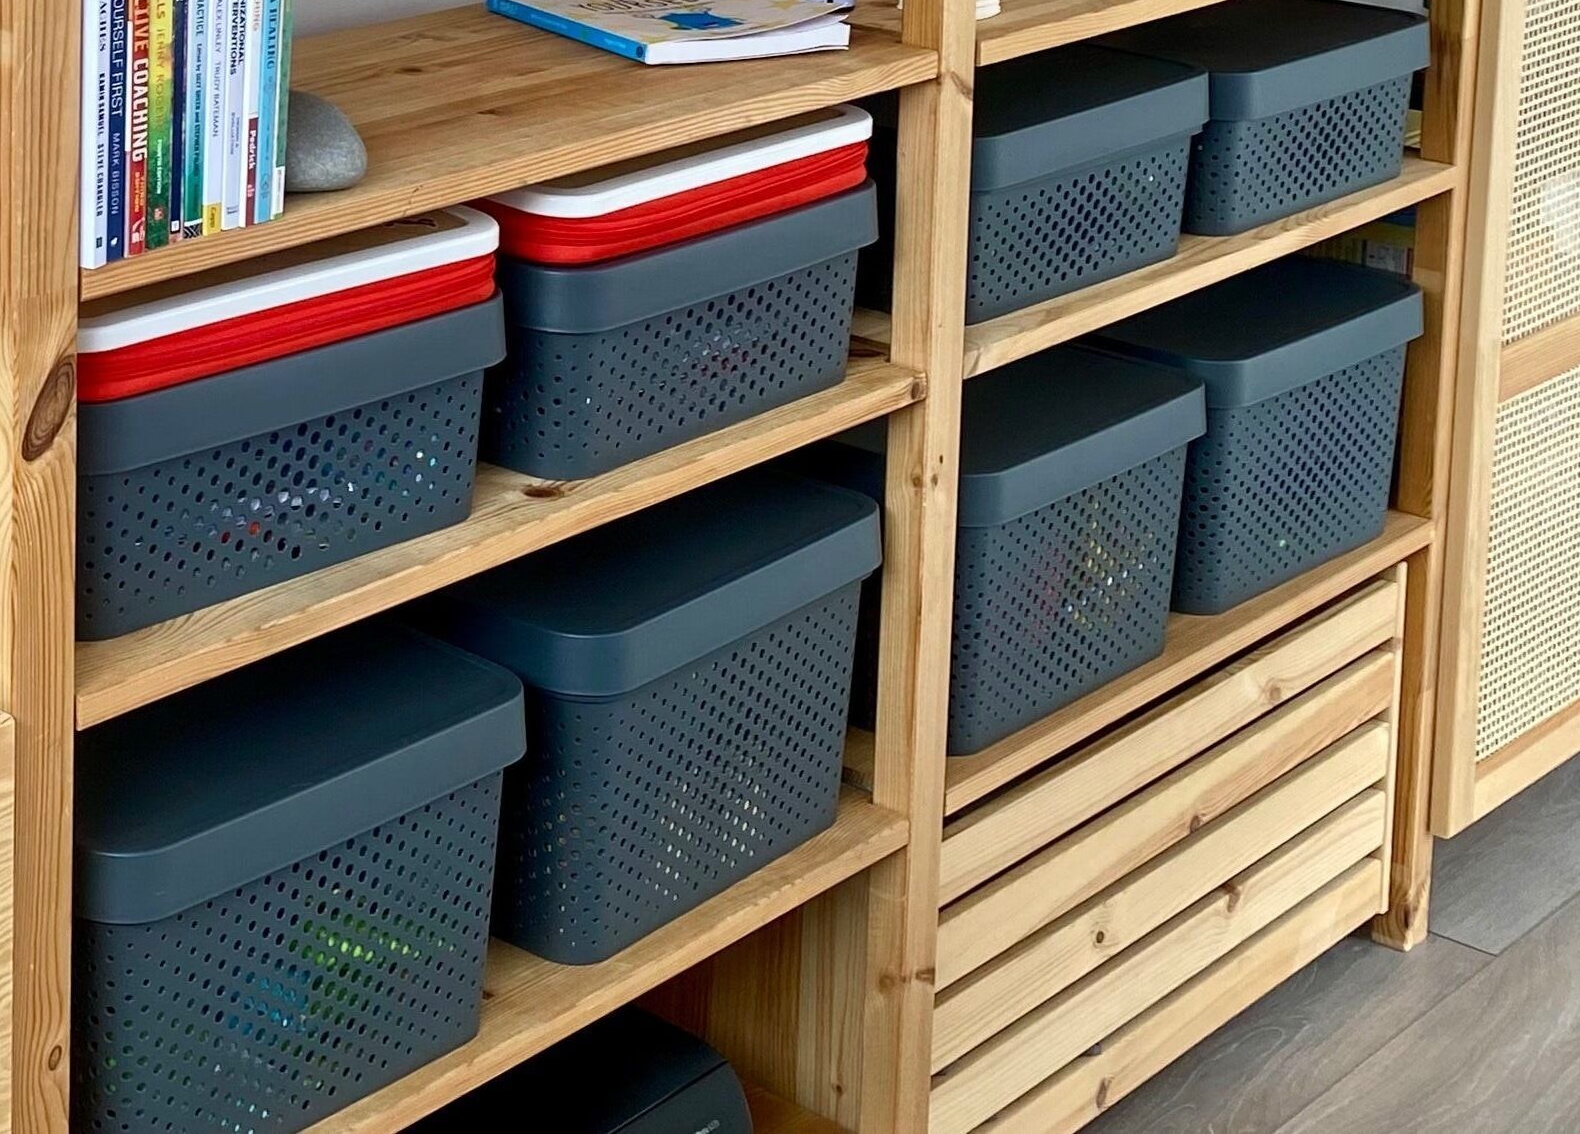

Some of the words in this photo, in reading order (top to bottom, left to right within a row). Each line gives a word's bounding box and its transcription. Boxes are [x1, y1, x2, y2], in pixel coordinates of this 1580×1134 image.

[266, 8, 278, 70] HEALING
[110, 71, 124, 117] FIRST
[213, 61, 222, 91] TRUDY
[132, 56, 149, 163] COACHING
[212, 93, 220, 138] BATEMAN
[96, 143, 104, 169] STEVE
[111, 132, 121, 167] MARK
[248, 129, 257, 170] Pedrick
[95, 172, 103, 218] CHANDLER
[110, 170, 120, 215] BISSON
